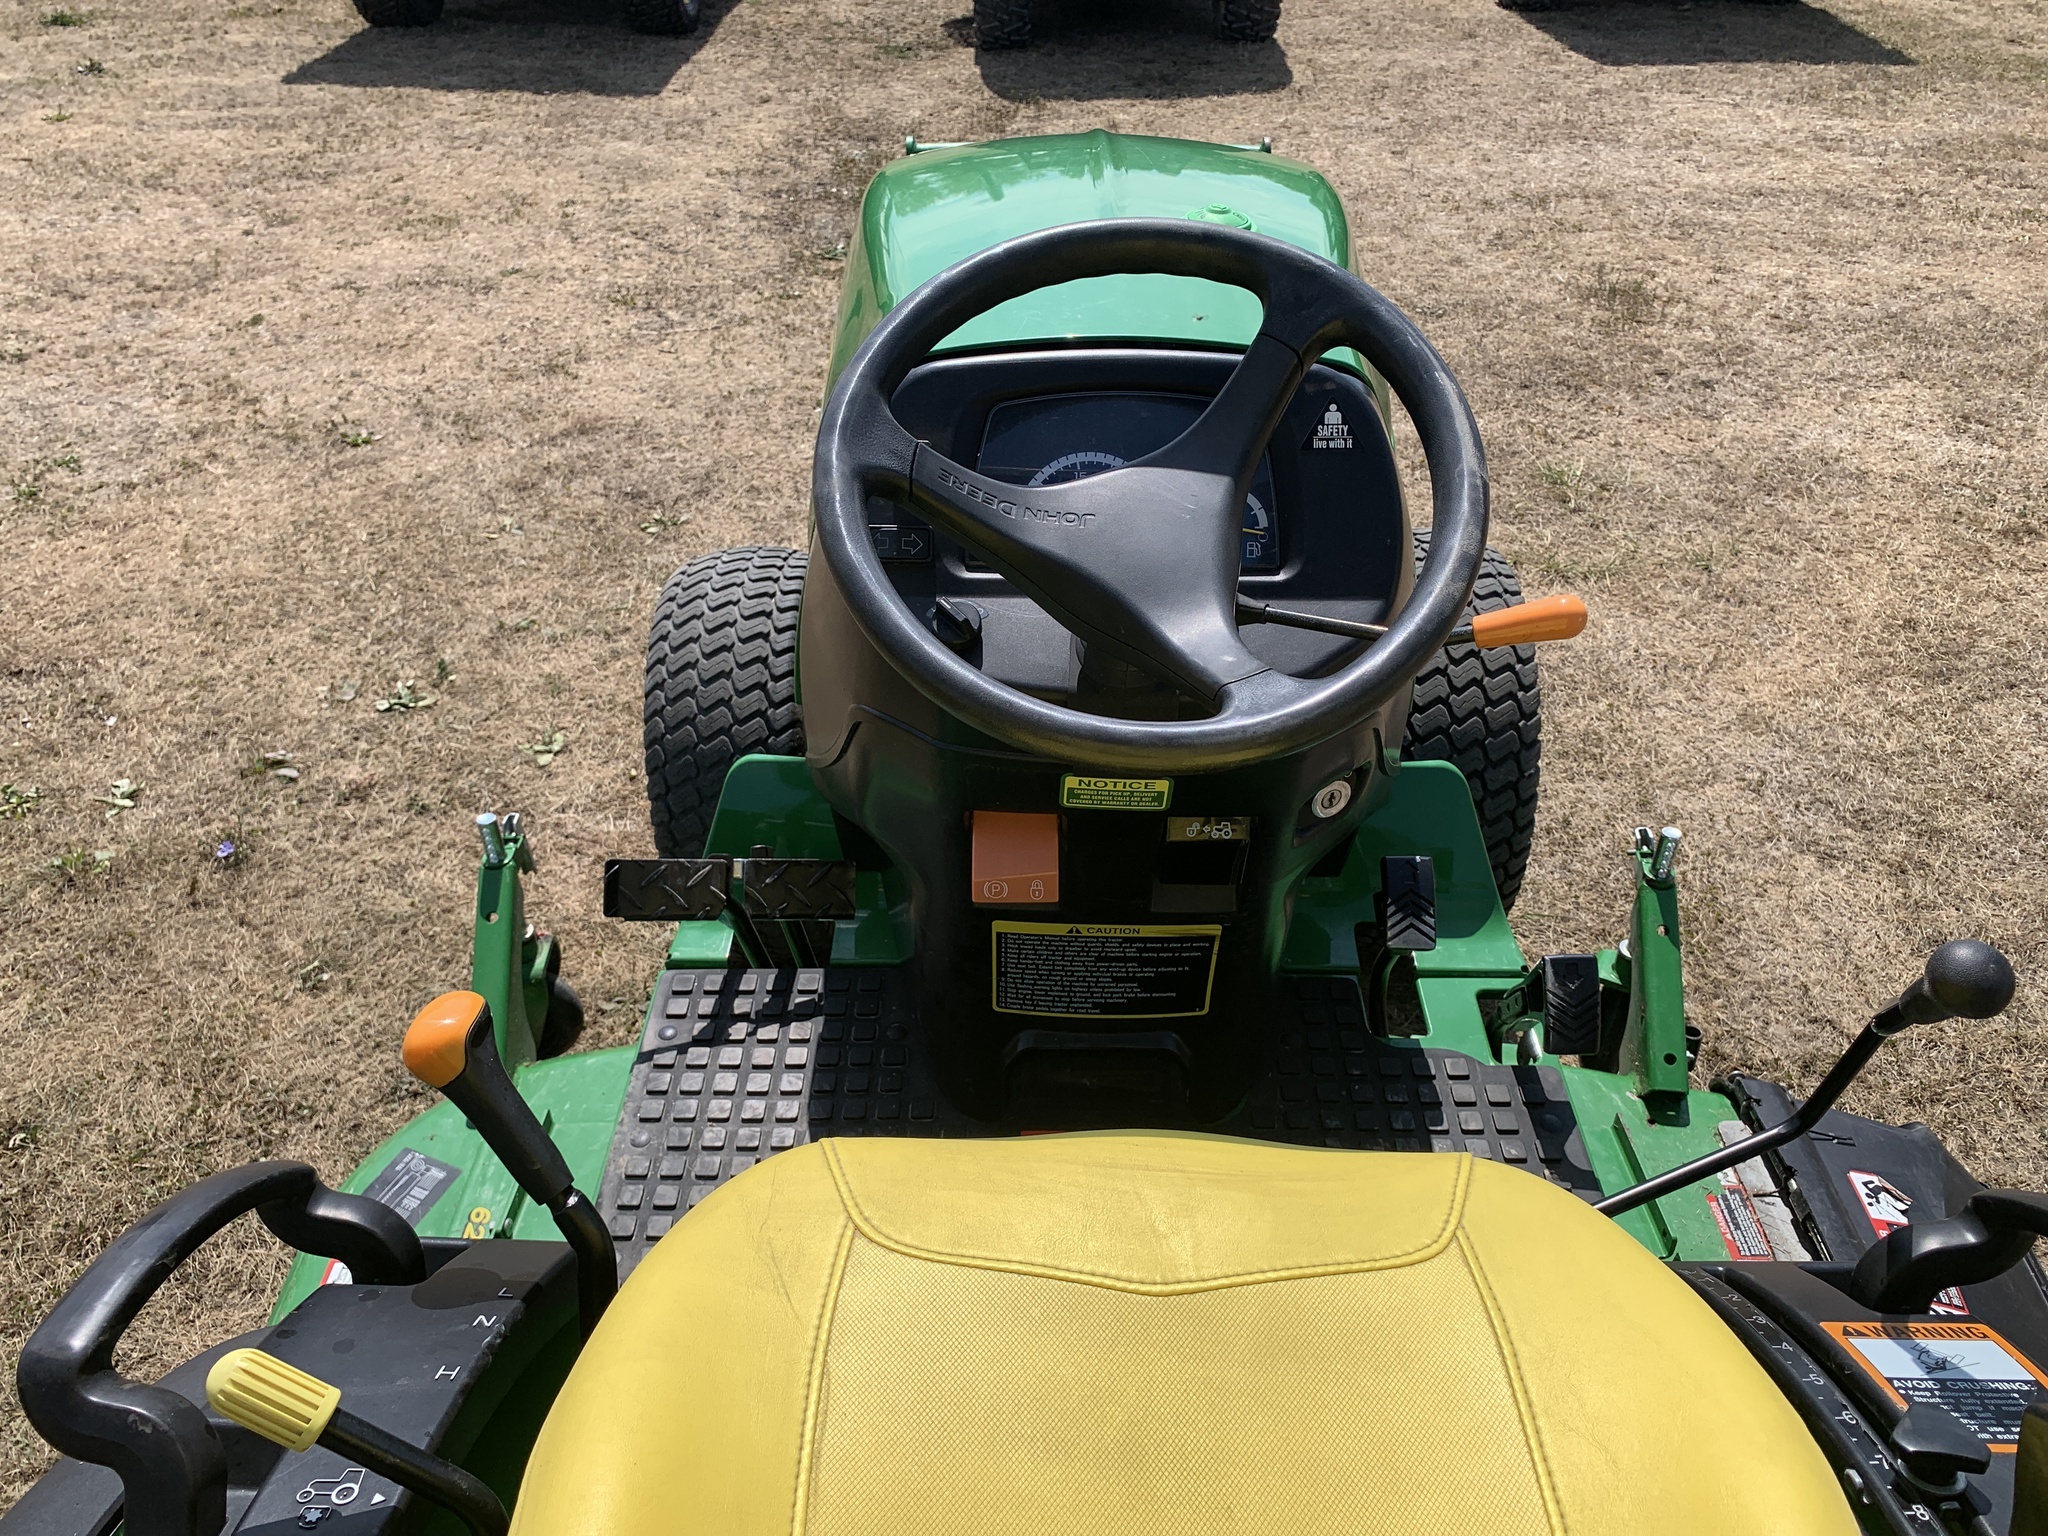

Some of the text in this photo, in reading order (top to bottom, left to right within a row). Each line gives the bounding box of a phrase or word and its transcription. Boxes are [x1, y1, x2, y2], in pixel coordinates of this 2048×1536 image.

[1317, 424, 1349, 436] SAFETY
[1313, 438, 1353, 449] live with it
[937, 467, 1096, 529] JOHN DEERE
[1078, 779, 1157, 790] NOTICE
[991, 884, 1000, 895] P
[1086, 927, 1141, 935] CAUTION
[462, 1206, 491, 1239] 62
[1710, 1201, 1731, 1233] DANGER
[497, 1287, 514, 1297] L
[1728, 1293, 1742, 1301] 2
[472, 1314, 498, 1328] N
[1863, 1325, 1991, 1339] WARNING
[1782, 1341, 1794, 1351] 4
[434, 1364, 462, 1380] H
[1808, 1373, 1825, 1385] 5
[1892, 1379, 2035, 1390] AVOID CRUSHING:
[1841, 1410, 1857, 1425] 6
[1911, 1504, 1930, 1521] 8
